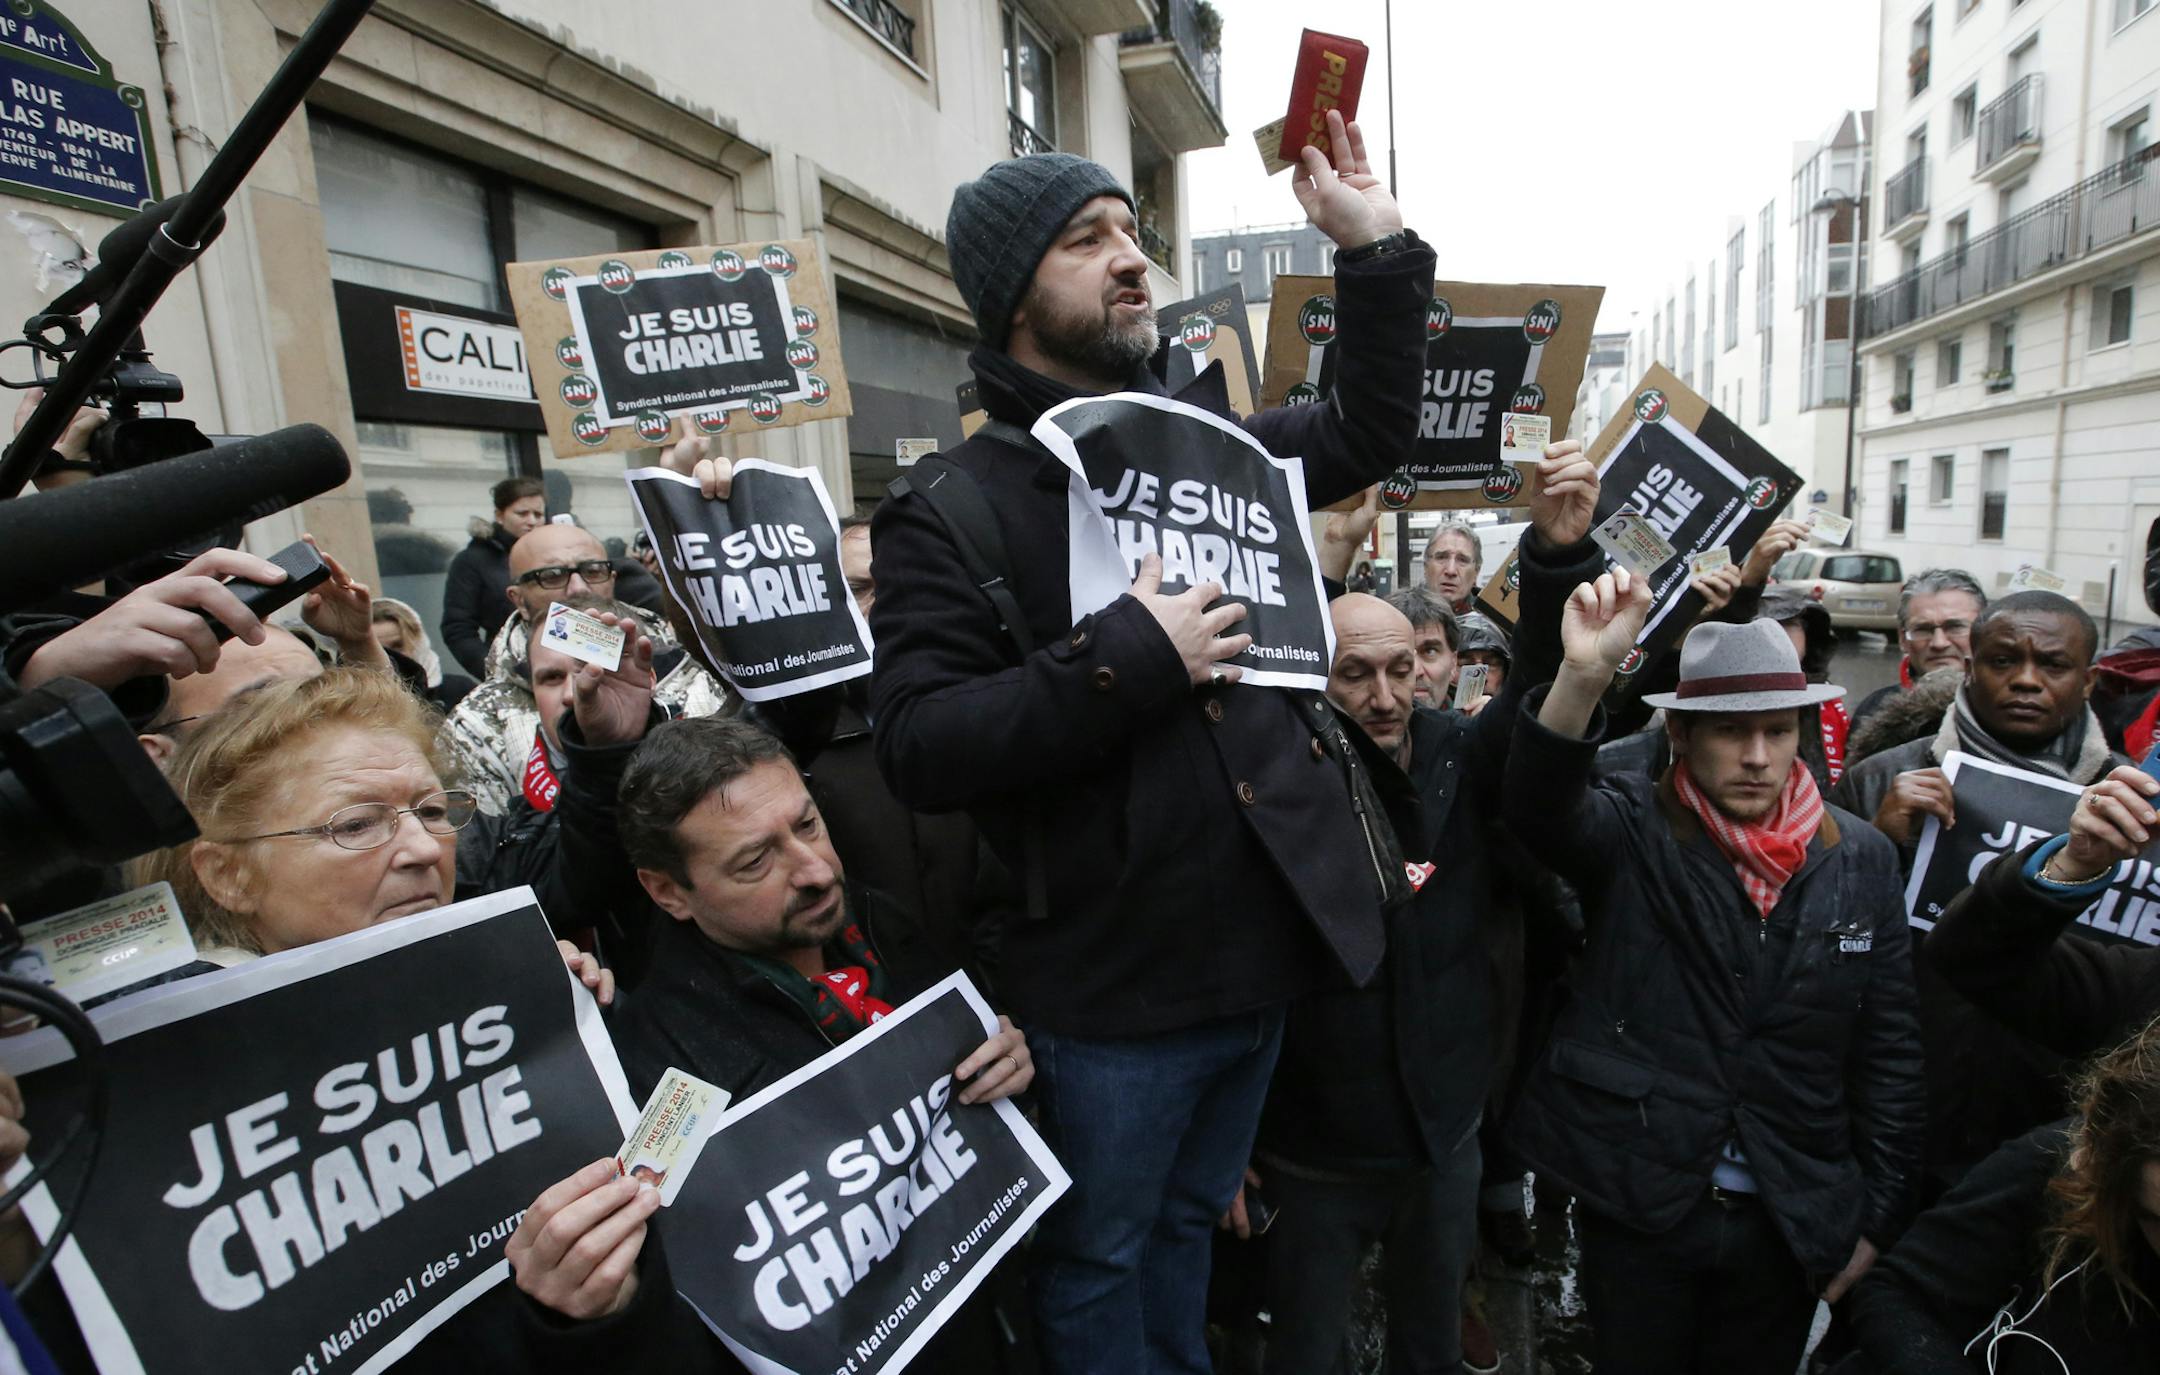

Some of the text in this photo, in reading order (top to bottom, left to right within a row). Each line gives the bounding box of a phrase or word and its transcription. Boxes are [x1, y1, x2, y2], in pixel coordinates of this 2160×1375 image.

[11, 78, 66, 111] RUE
[2, 127, 37, 144] 1749
[56, 116, 136, 154] APPERT
[52, 164, 136, 194] ALIMENTAIRE
[70, 156, 88, 171] DE
[100, 164, 117, 177] LA
[619, 302, 753, 340] JE SUIS
[796, 314, 814, 328] NJ
[1428, 311, 1446, 328] NJ
[421, 326, 523, 373] CALI
[623, 328, 764, 375] CHARLIE
[425, 370, 450, 383] des
[616, 379, 790, 412] Syndicat National des Journalistes
[1411, 464, 1429, 473] des
[1432, 463, 1494, 473] Journalistes
[1093, 468, 1278, 544] JE SUIS
[673, 523, 816, 571] JE SUIS
[1104, 516, 1287, 607] HARLIE
[1654, 562, 1685, 599] National
[1696, 496, 1739, 549] Journalistes
[685, 563, 831, 628] HARLIE
[783, 654, 806, 669] des
[807, 643, 856, 664] Journalistes
[1243, 643, 1320, 662] ournalistes
[53, 917, 124, 948] PRESSE
[130, 904, 166, 924] 2014
[56, 932, 118, 957] DOMINIQUE
[119, 914, 171, 936] PRADALIE
[162, 1091, 300, 1209] JE
[314, 1004, 515, 1135] SUIS
[643, 1105, 674, 1150] PRESSE
[669, 1081, 688, 1106] 2014
[655, 1115, 676, 1146] VINCENT
[187, 1064, 543, 1311] CHARLIE
[733, 1170, 829, 1262] JE
[753, 1111, 977, 1331] CHARLIE
[855, 1286, 922, 1362] National
[920, 1259, 950, 1292] des
[951, 1176, 1029, 1263] Journalistes
[320, 1276, 417, 1365] National
[420, 1252, 460, 1289] des
